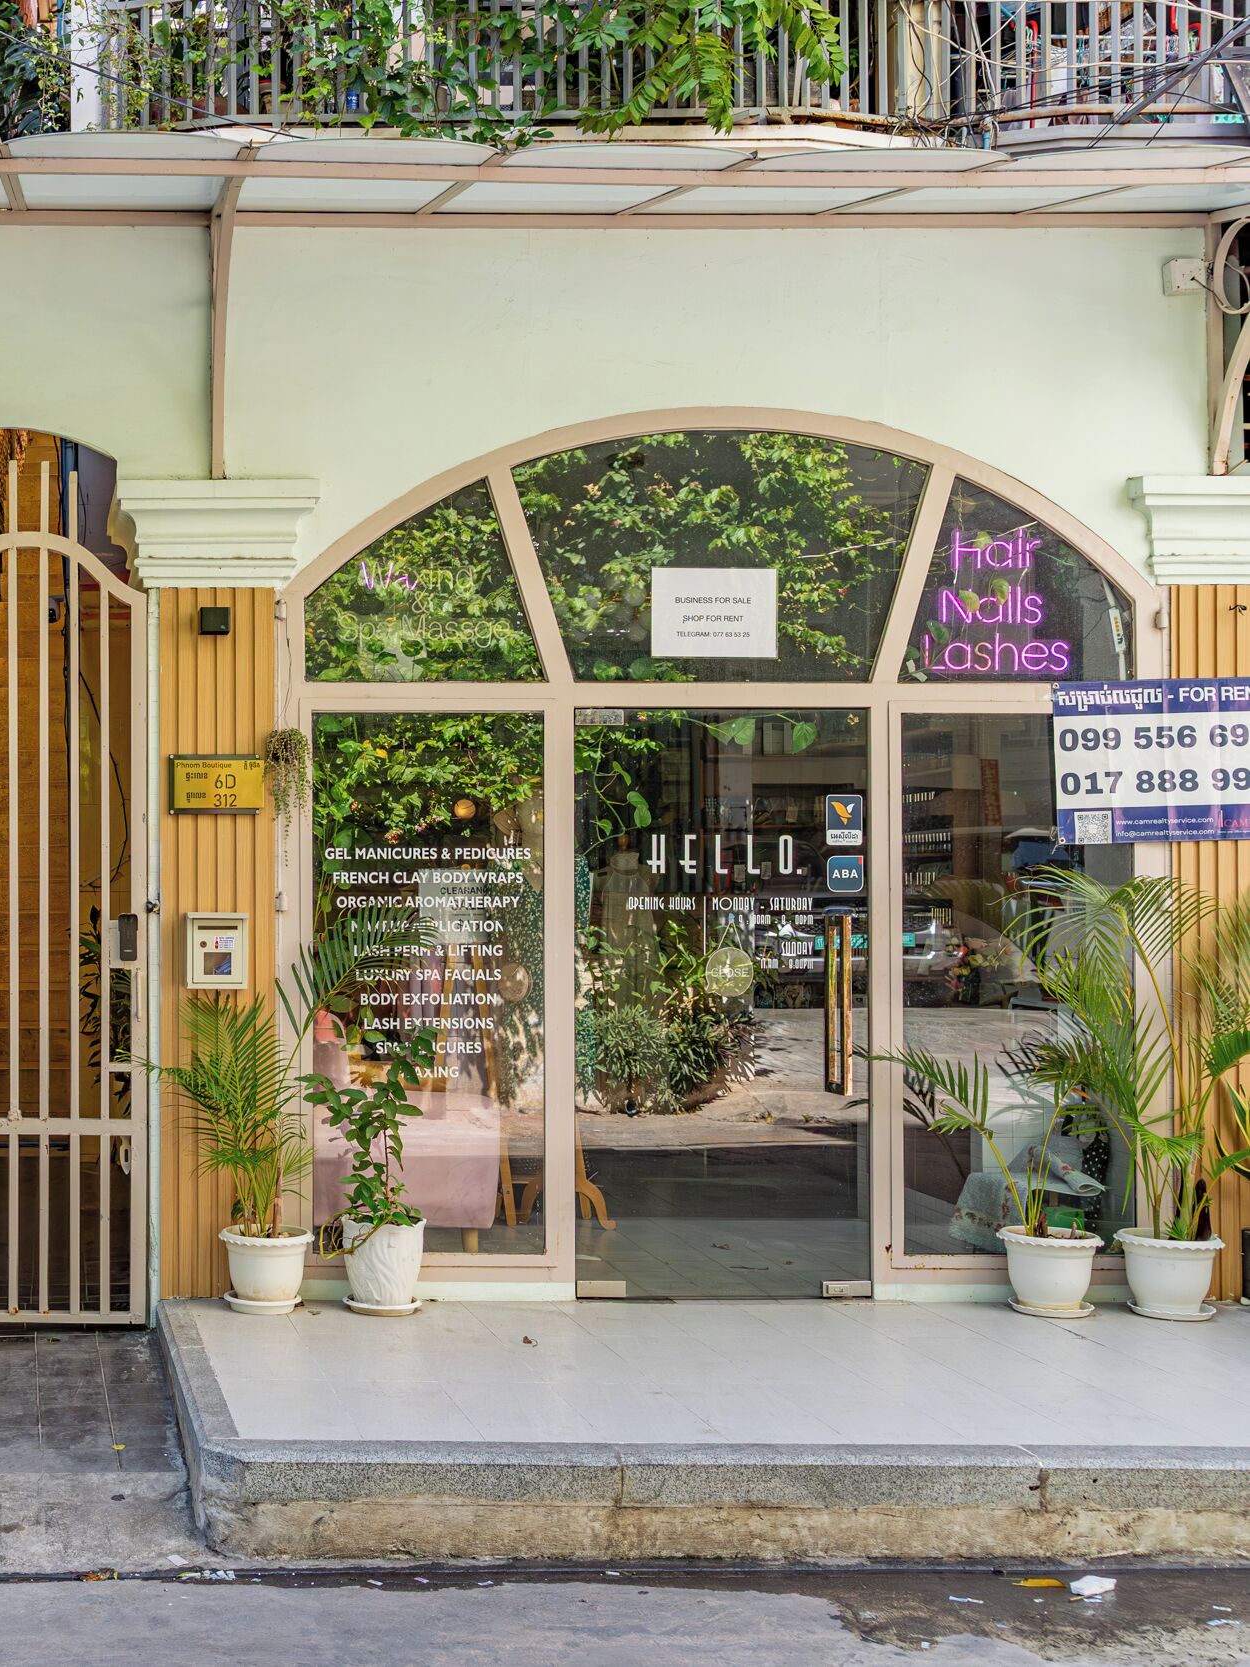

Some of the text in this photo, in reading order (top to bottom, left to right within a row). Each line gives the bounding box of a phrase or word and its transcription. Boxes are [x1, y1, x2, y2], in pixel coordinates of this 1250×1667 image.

[954, 528, 1042, 569] Hair
[361, 560, 475, 597] Waxing
[411, 589, 428, 614] &
[674, 596, 714, 604] BUSINESS
[732, 597, 752, 605] SALE
[942, 586, 1043, 624] Nails
[682, 614, 744, 623] SHOP FOR RENT
[401, 614, 511, 649] Massge
[924, 633, 1069, 672] Lashes
[1179, 686, 1217, 702] FOR
[1059, 723, 1250, 752] 099 556 69
[176, 761, 232, 770] Phnom Boutique
[214, 774, 237, 789] 6D
[1060, 767, 1250, 796] 017 888 99
[213, 793, 237, 808] 312
[1115, 816, 1214, 826] www.camrealtyservice.com
[1115, 828, 1215, 839] info@camrealtyservice.com
[324, 847, 531, 860] GEL MANICURES & PEDICURES
[332, 871, 524, 884] FRENCH CLAY BODY WRAPS
[832, 869, 859, 879] ABA
[440, 886, 490, 895] CLEARAN
[336, 895, 403, 908] ORGANIC
[405, 895, 520, 908] AROMATHERAPY
[628, 896, 665, 911] OPENING
[668, 896, 696, 911] HOURS
[712, 896, 755, 911] MONDAY
[770, 896, 813, 911] SATURDAY
[795, 914, 814, 925] 00PM
[353, 944, 503, 957] LASH PERM & LIFTING
[781, 941, 813, 955] SUNDAY
[355, 968, 502, 981] LUXURY SPA FACIALS
[711, 967, 750, 978] CLOSE
[360, 993, 498, 1006] BODY EXFOLIATION
[363, 1017, 494, 1030] LASH EXTENSIONS
[375, 1042, 400, 1054] SPA
[400, 1066, 460, 1078] AXING
